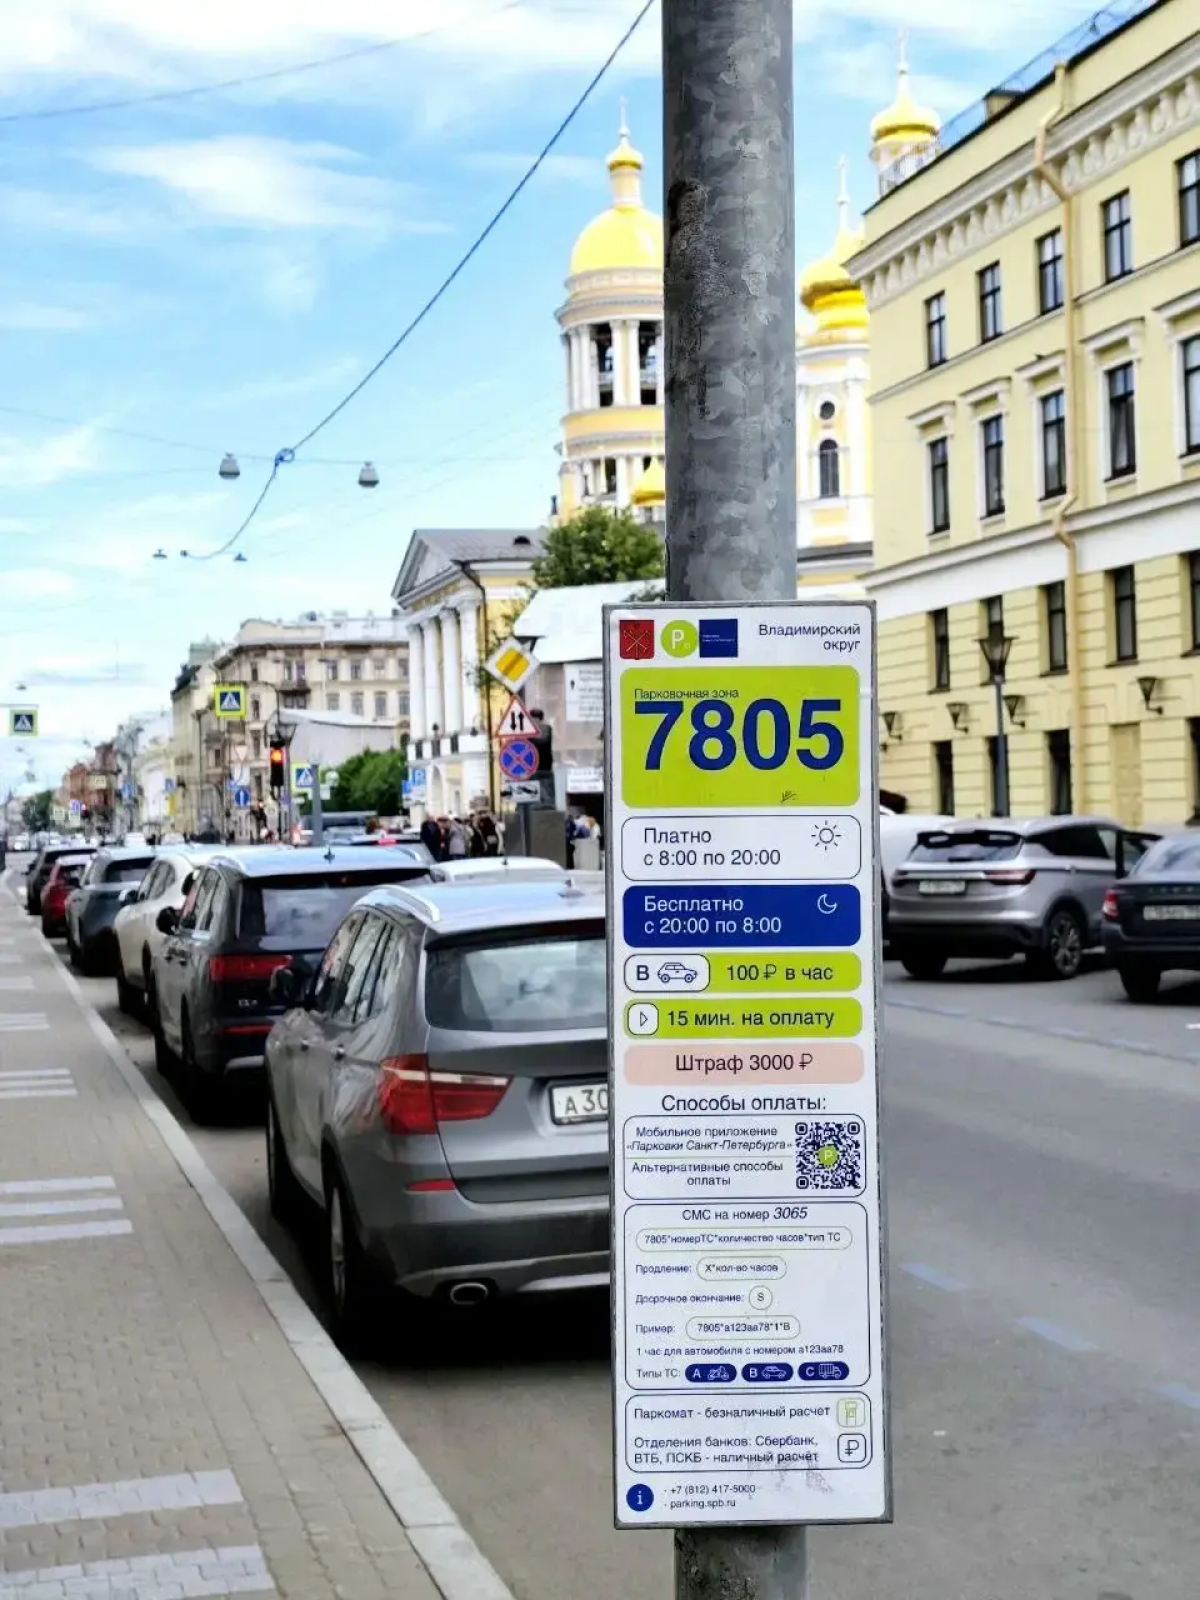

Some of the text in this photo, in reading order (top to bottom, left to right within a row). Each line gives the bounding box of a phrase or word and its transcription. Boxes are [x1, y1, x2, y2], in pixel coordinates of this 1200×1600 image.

[758, 623, 861, 637] Владимирский
[822, 638, 861, 651] округ
[634, 688, 740, 700] Парковочная зона
[634, 698, 845, 771] 7805
[643, 827, 712, 844] Платно
[643, 849, 781, 866] с 8:00 по 20:00
[644, 895, 744, 912] Бесплатно
[644, 916, 782, 934] с 20:00 по 8:00
[726, 964, 760, 981] 100
[785, 967, 796, 980] в
[802, 966, 834, 980] час
[668, 1010, 835, 1029] 15 мин. на оплату
[675, 1053, 744, 1075] Штраф
[749, 1054, 794, 1071] 3000
[661, 1094, 827, 1112] Способы оплаты:
[636, 1127, 778, 1138] Мобильное приложение
[626, 1139, 793, 1152] «Парковки Санкт-Петербурга»
[631, 1160, 784, 1174] Альтернативные способы
[686, 1175, 731, 1186] оплаты
[682, 1206, 808, 1222] СМС на номер 3065
[827, 1232, 841, 1243] ТС
[635, 1264, 692, 1275] Продление:
[749, 1263, 779, 1273] часов
[635, 1293, 745, 1304] Досрочное окончание:
[756, 1292, 765, 1302] S
[635, 1324, 676, 1335] Пример:
[636, 1347, 641, 1356] 1
[644, 1348, 662, 1357] час
[663, 1348, 682, 1358] для
[684, 1346, 743, 1357] автомобиля
[745, 1348, 751, 1356] с
[753, 1346, 796, 1357] номером
[636, 1368, 681, 1380] Типы ТС:
[634, 1407, 694, 1420] Паркомат
[704, 1405, 786, 1419] безналичный
[789, 1405, 831, 1420] расчет
[634, 1434, 819, 1449] Отделения банков: Сбербанк,
[634, 1452, 662, 1465] ВТБ,
[666, 1451, 702, 1464] ПСКБ
[713, 1450, 774, 1464] наличный
[670, 1483, 756, 1496] +7 (812) 417-5000
[669, 1497, 736, 1511] parking.spb.ru
